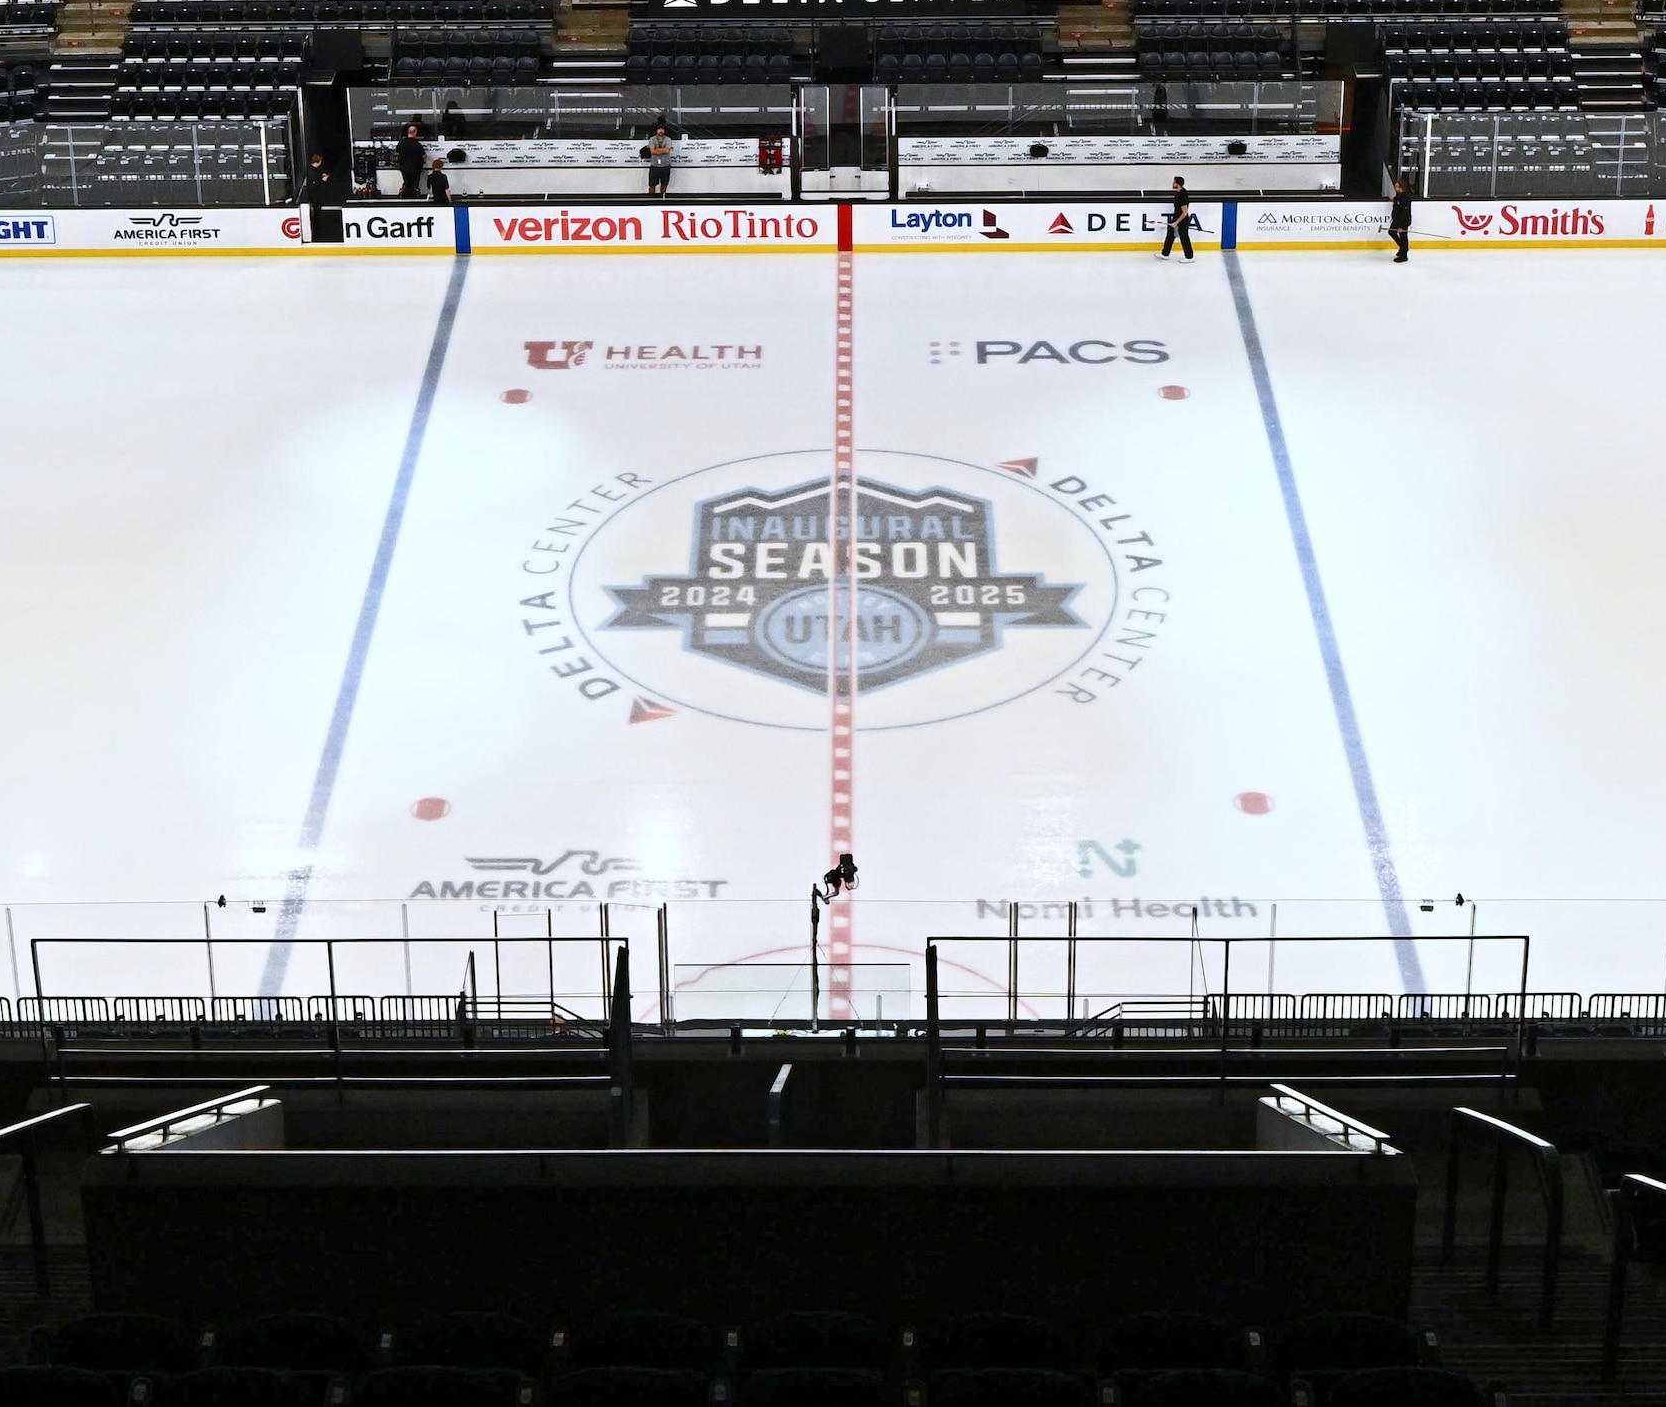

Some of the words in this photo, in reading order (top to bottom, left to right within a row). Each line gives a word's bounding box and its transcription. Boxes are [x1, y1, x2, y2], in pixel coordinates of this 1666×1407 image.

[367, 216, 434, 239] Garff
[493, 210, 642, 241] verizon
[661, 210, 721, 239] Rio
[724, 210, 818, 239] Tinto
[891, 209, 972, 233] Layton
[1343, 214, 1353, 224] &
[1498, 204, 1605, 235] Smith's
[114, 229, 178, 240] AMERICA
[181, 229, 221, 239] FIRST
[605, 345, 762, 360] HEALTH
[976, 340, 1170, 364] PACS
[605, 362, 693, 370] UNIVERSITY
[697, 362, 716, 370] OF
[719, 362, 763, 370] UTAH
[523, 472, 653, 575] CENTER
[711, 516, 974, 540] INAUGURAL
[1049, 475, 1163, 573] DELTA
[709, 542, 977, 579] SEASON
[662, 586, 756, 606] 2024
[931, 585, 1025, 605] 2025
[786, 615, 900, 644] UTAH
[519, 591, 621, 701] DELTA
[1054, 586, 1170, 704] CENTER
[409, 880, 596, 899] AMERICA
[1112, 896, 1258, 919] Health
